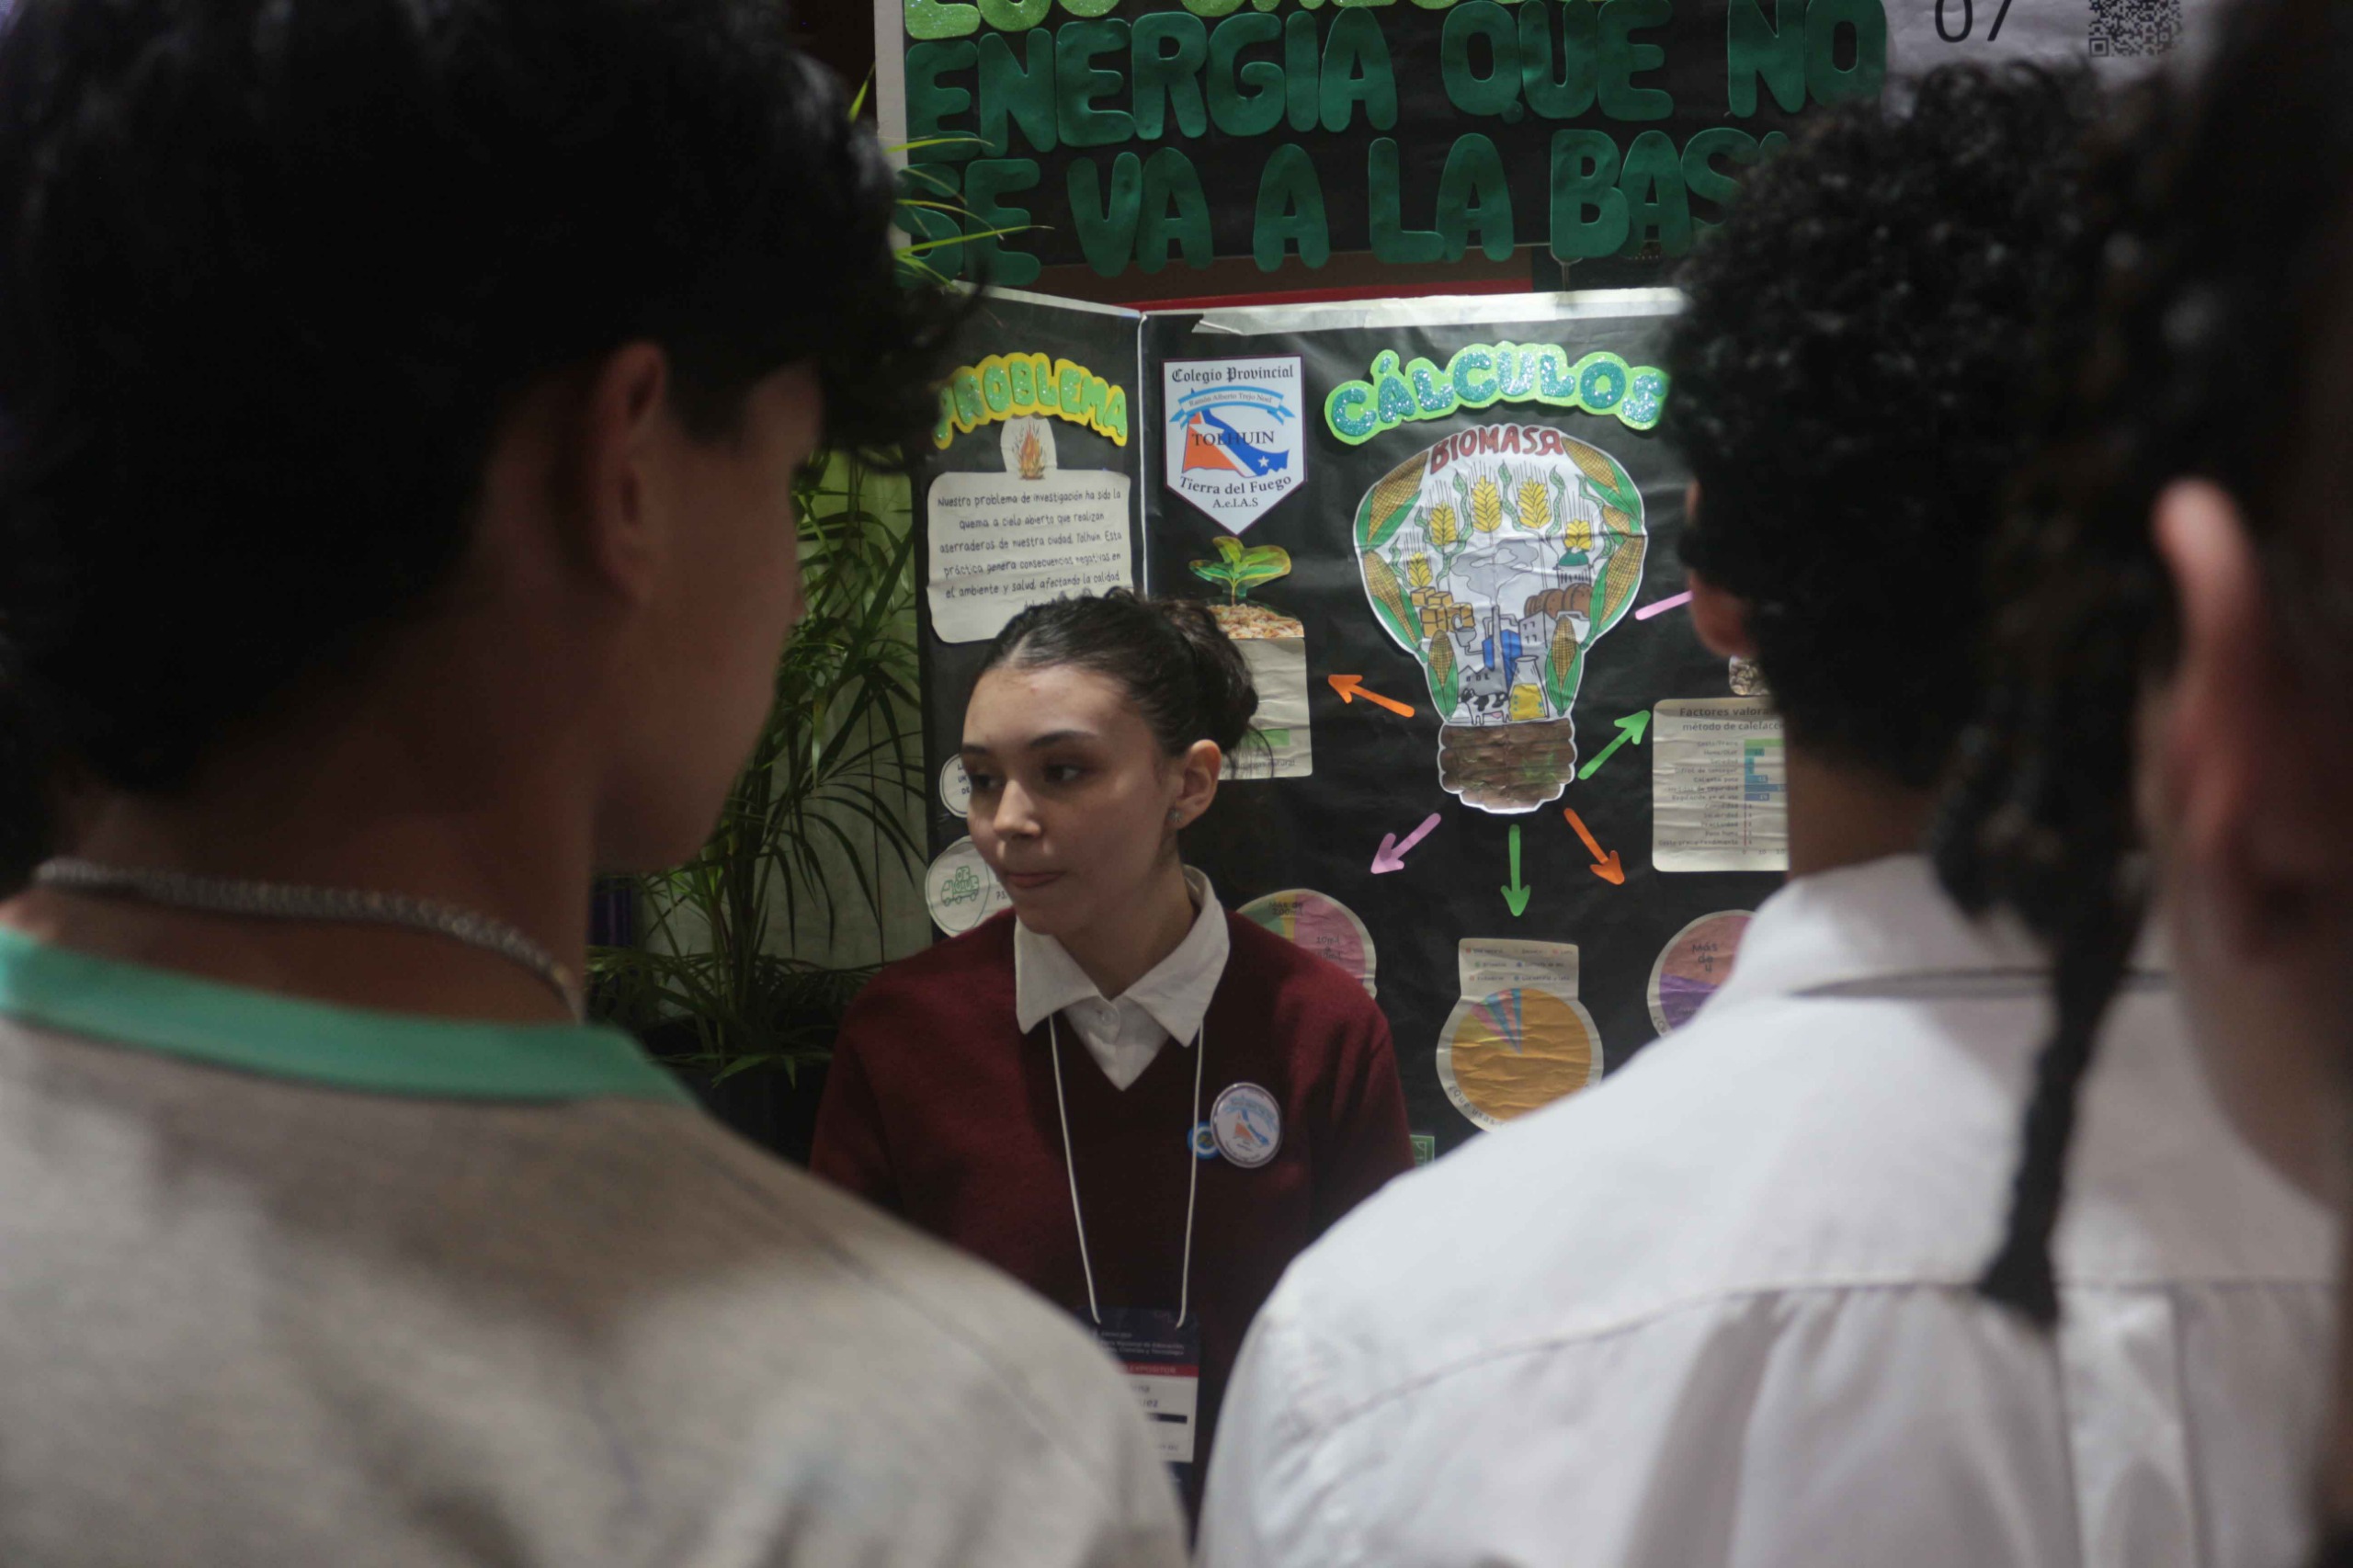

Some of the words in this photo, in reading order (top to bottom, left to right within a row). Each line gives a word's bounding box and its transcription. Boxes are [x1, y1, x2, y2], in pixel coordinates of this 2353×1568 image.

[906, 6, 1398, 162] ENERGIA
[1441, 1, 1674, 124] QUE
[1727, 0, 1887, 117] NO
[1066, 147, 1213, 277] VA
[1253, 143, 1330, 272] A
[1369, 133, 1515, 264] LA
[1551, 127, 1790, 261] BAS
[1172, 368, 1222, 384] Colegio
[1226, 364, 1294, 383] Provincial
[1212, 392, 1236, 402] Alberto
[1332, 350, 1665, 436] CÁLCULOS
[1192, 430, 1275, 446] TOLHUIN
[1429, 426, 1564, 474] BIOMASA
[1179, 475, 1220, 494] Tierra
[1224, 483, 1245, 494] del
[1250, 476, 1291, 494] Fuego
[938, 495, 972, 507] Nuestro
[974, 493, 1017, 507] problema
[1020, 492, 1031, 504] de
[1033, 490, 1083, 505] investigación
[1085, 488, 1095, 500] ha
[1097, 487, 1111, 500] sido
[1113, 487, 1121, 499] la
[959, 519, 989, 531] quema
[993, 518, 999, 528] a
[1002, 514, 1021, 527] cielo
[1025, 515, 1054, 525] abierto
[1057, 515, 1071, 526] que
[1074, 510, 1105, 522] realizan
[939, 540, 995, 553] aserraderos
[999, 537, 1008, 550] de
[1012, 536, 1045, 548] nuestra
[1104, 530, 1122, 542] Esta
[944, 563, 983, 579] práctica
[987, 561, 1017, 574] genera
[1019, 555, 1074, 569] consecuencias
[1075, 552, 1109, 566] negativas
[1112, 552, 1121, 561] en
[945, 585, 955, 598] el
[959, 584, 999, 597] ambiente
[1003, 585, 1009, 596] y
[1040, 574, 1081, 589] afectando
[1083, 573, 1091, 585] la
[1093, 569, 1120, 584] calidad
[1679, 708, 1730, 717] Factores
[1682, 722, 1722, 732] método
[1723, 722, 1736, 731] de
